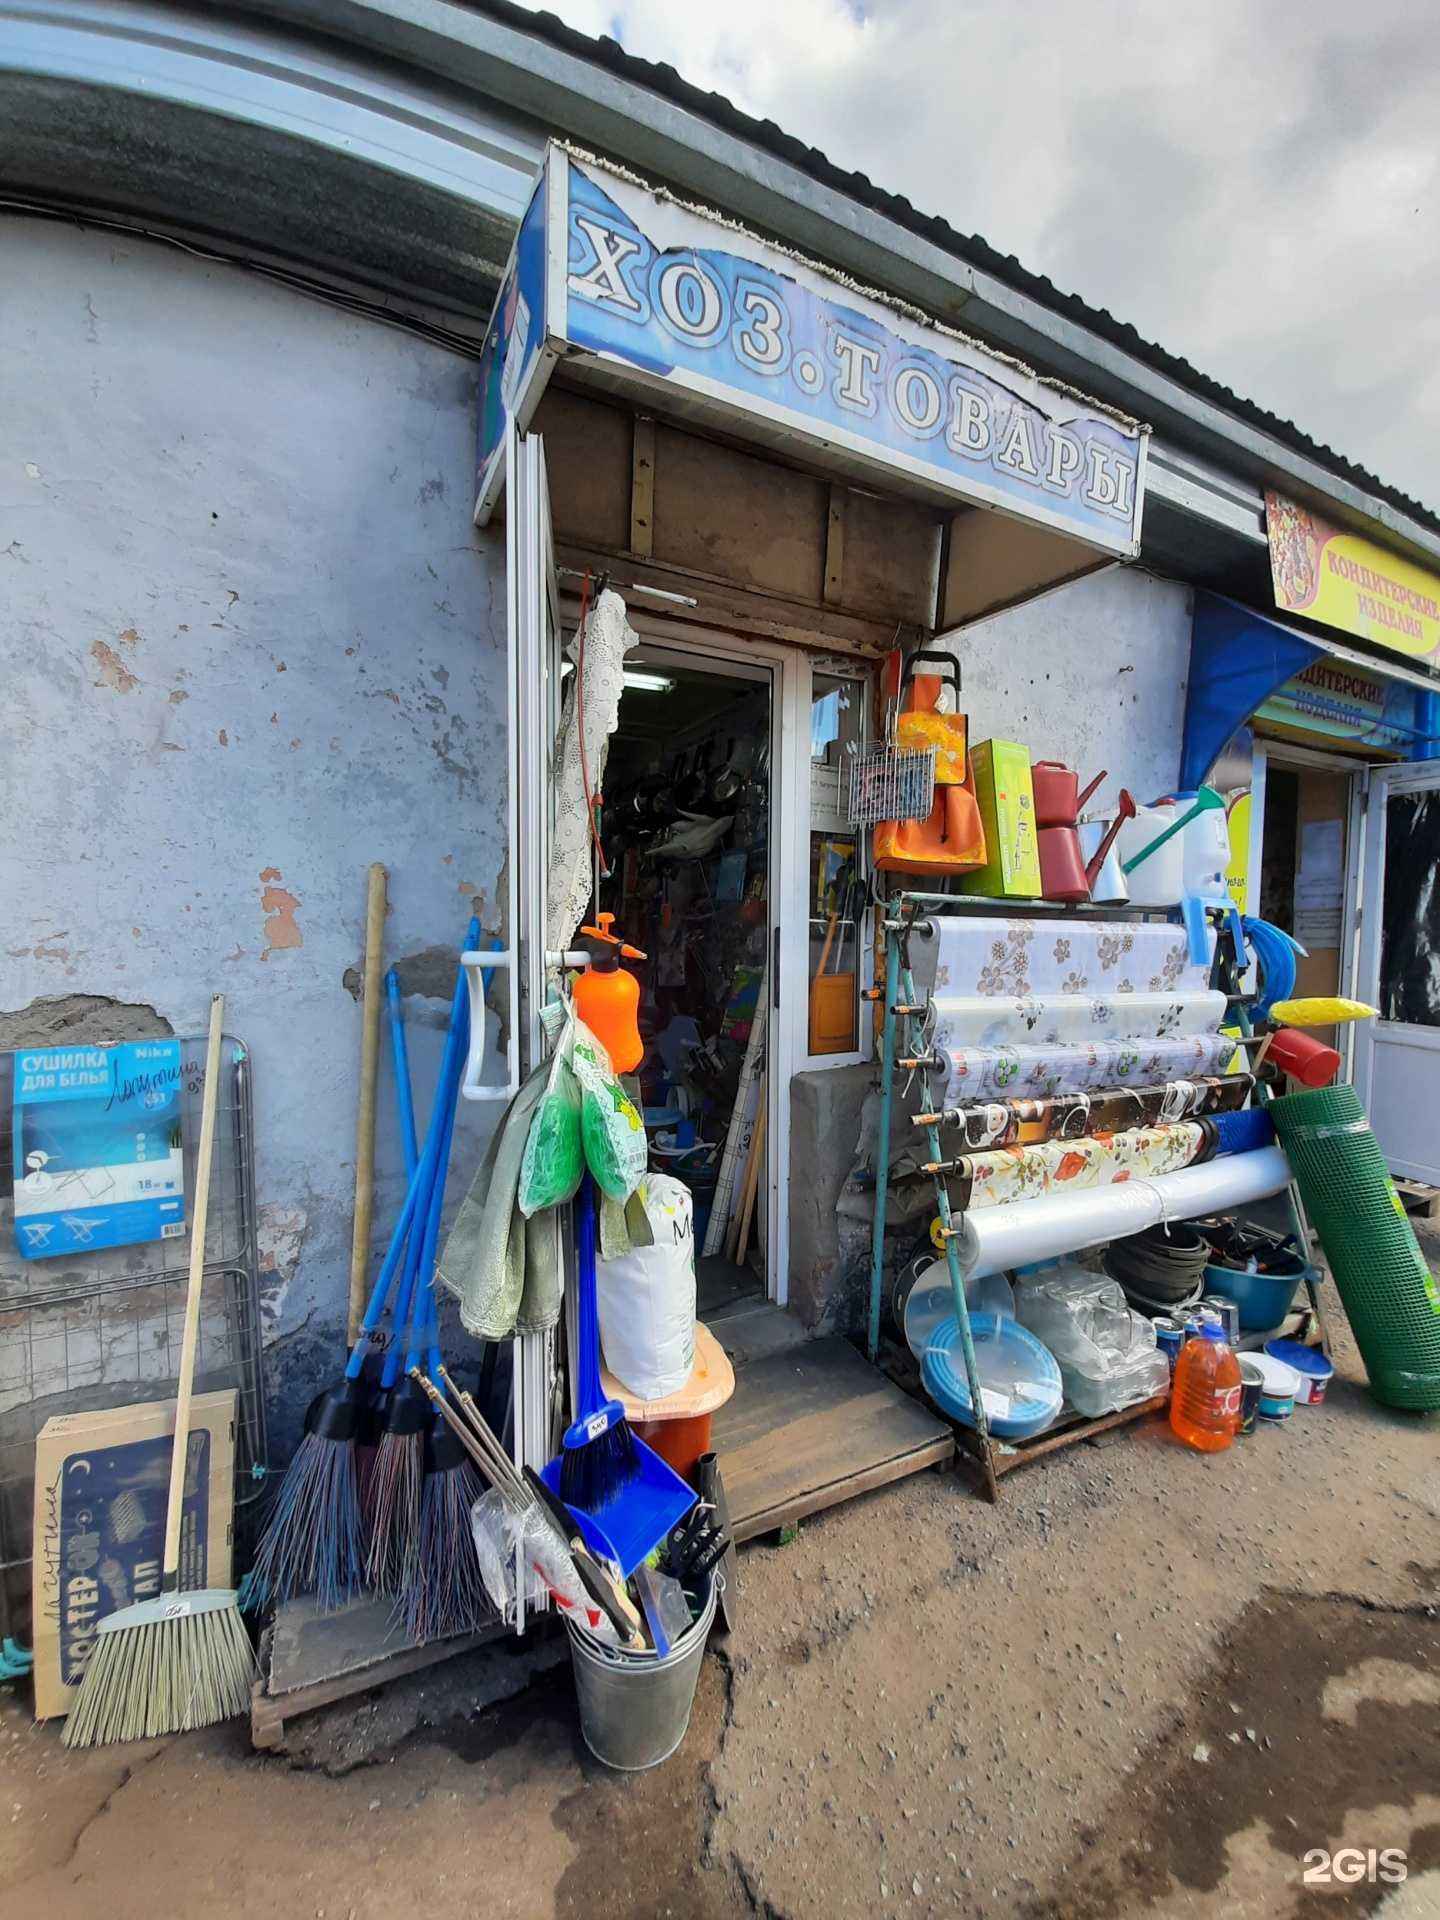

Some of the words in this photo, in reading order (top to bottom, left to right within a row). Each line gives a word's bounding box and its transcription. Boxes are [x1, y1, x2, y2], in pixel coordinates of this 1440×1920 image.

[567, 213, 1134, 520] ХОЗ.ТОВАРЫ
[1358, 592, 1424, 640] ИЗДЕЛИЯ
[22, 1051, 108, 1073] СУШИЛКА
[22, 1073, 55, 1092] ДЛЯ
[60, 1069, 109, 1088] БЕЛЬЯ
